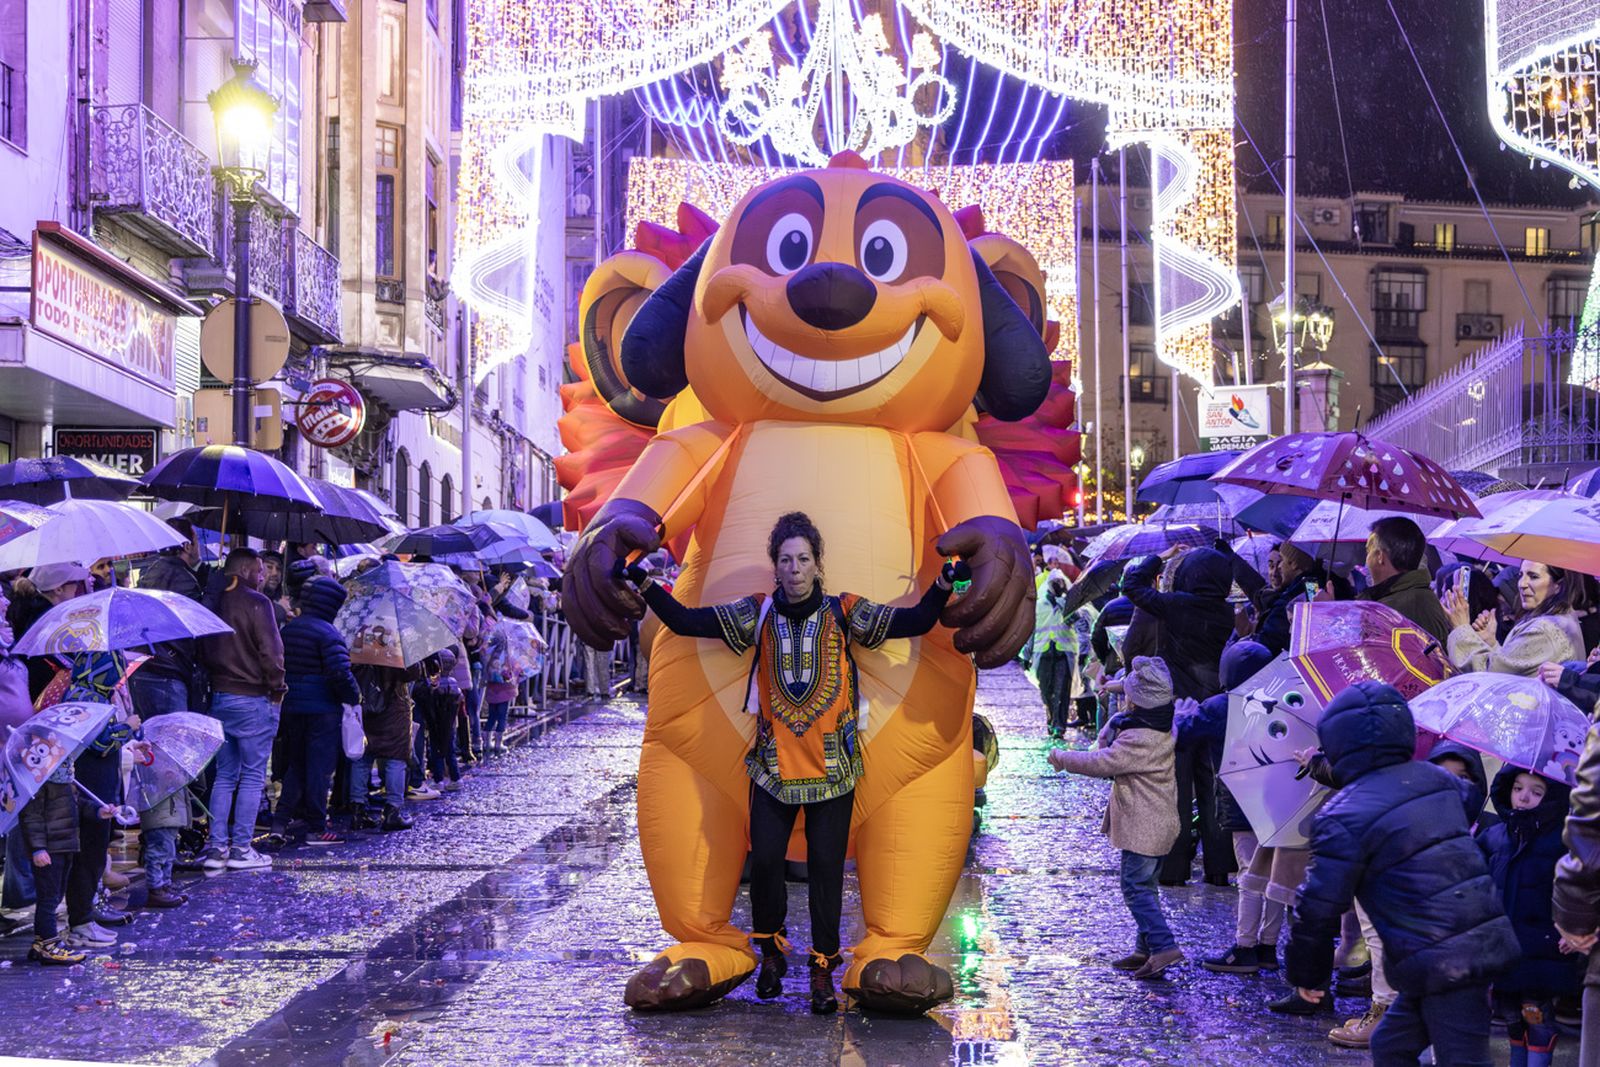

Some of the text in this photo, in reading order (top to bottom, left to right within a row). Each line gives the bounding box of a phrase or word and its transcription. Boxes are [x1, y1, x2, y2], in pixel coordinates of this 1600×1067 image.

[36, 251, 127, 336] OPORTUNIDADES
[36, 298, 70, 328] TODO
[59, 433, 153, 448] OPORTUNIDADES
[1209, 436, 1257, 444] DACIA
